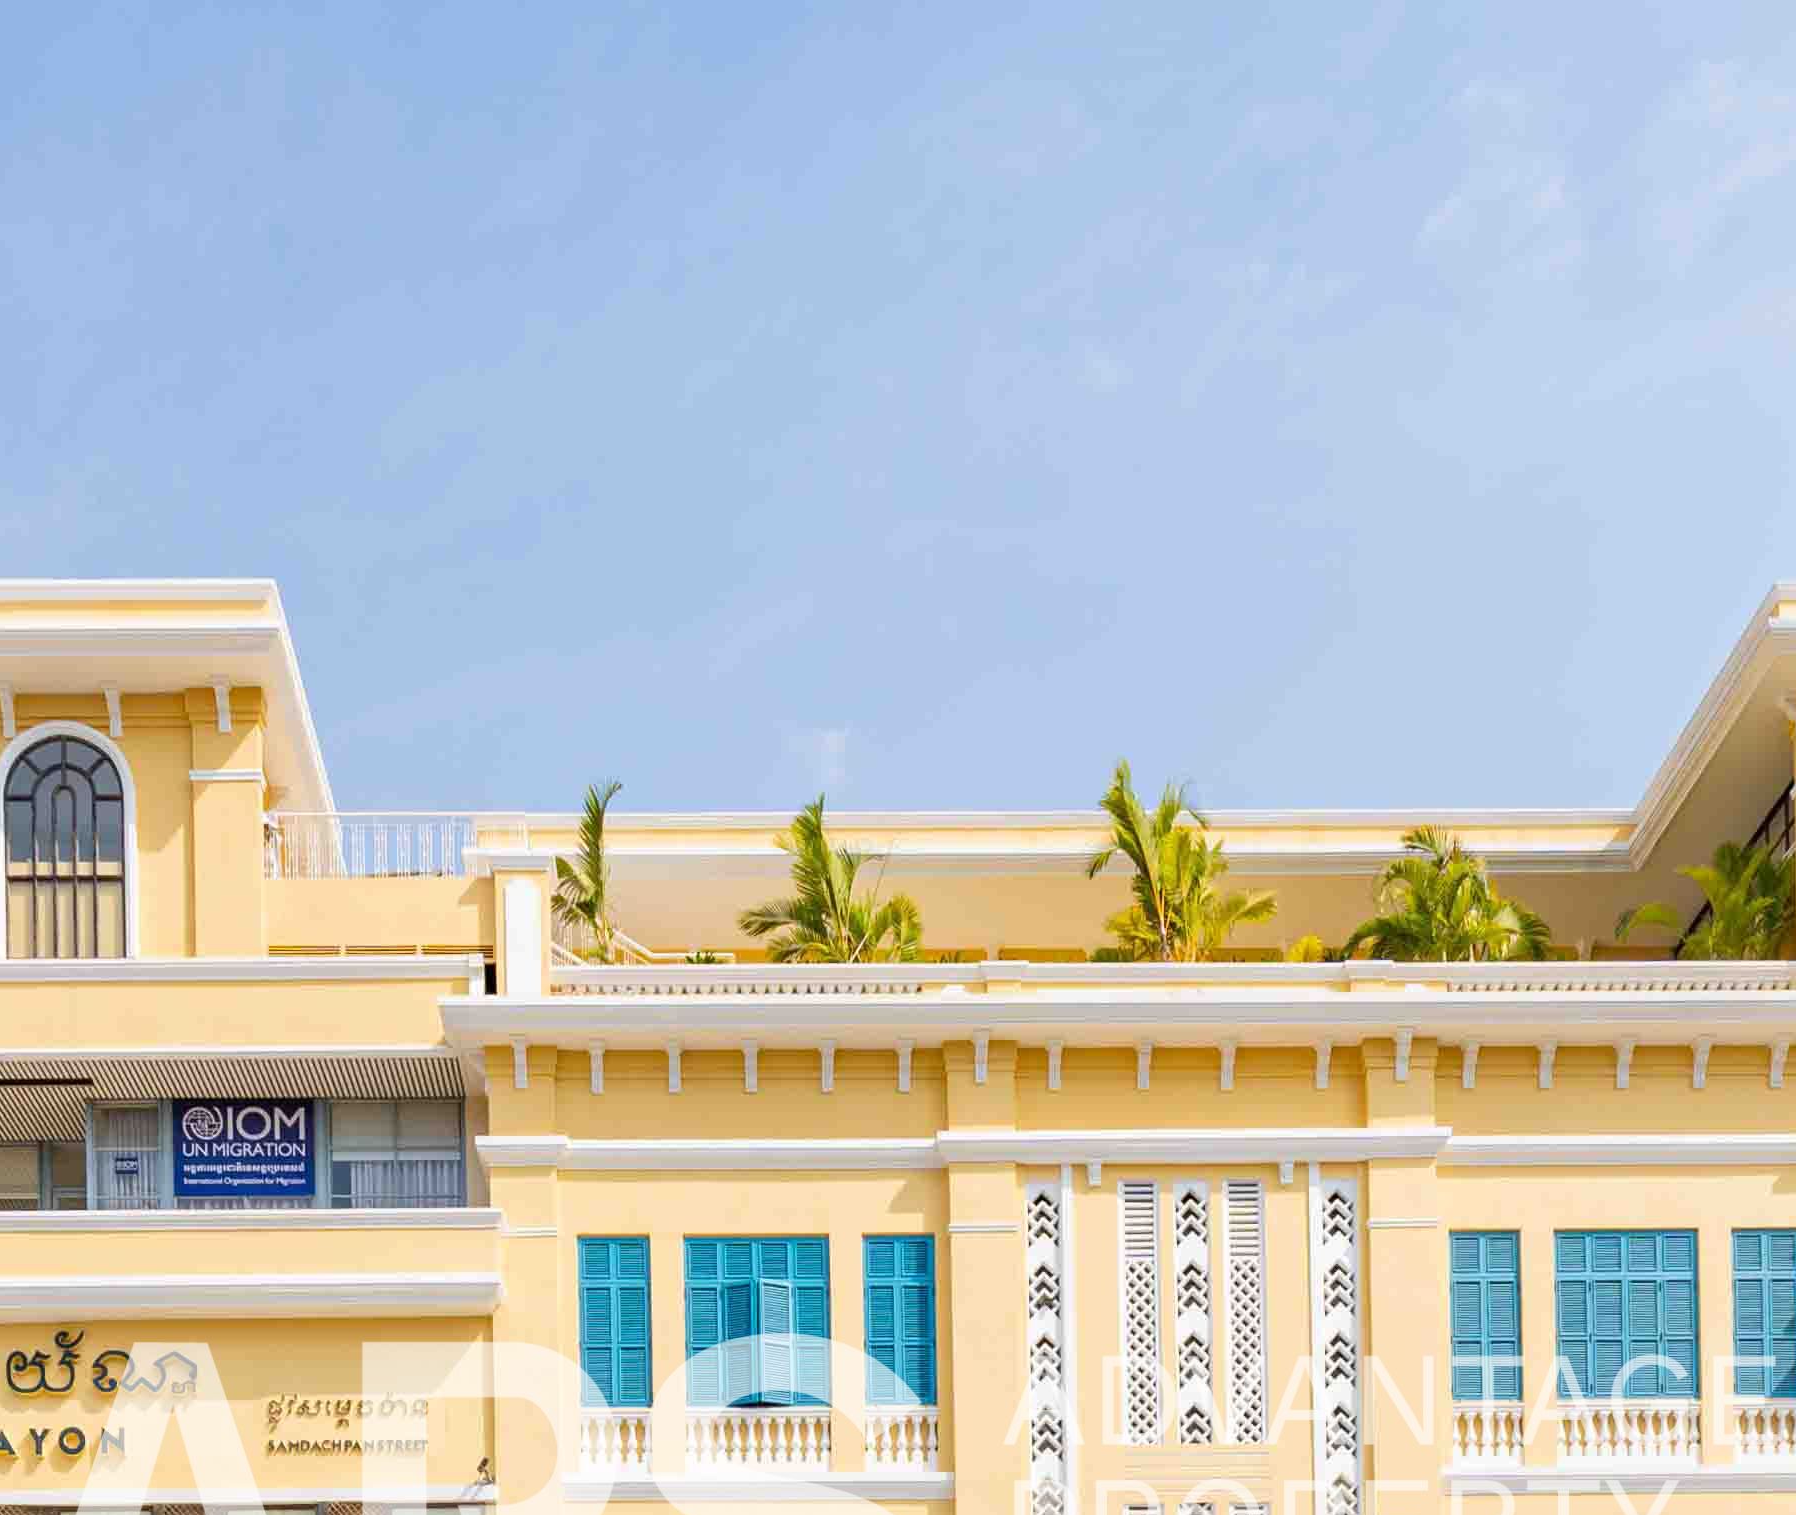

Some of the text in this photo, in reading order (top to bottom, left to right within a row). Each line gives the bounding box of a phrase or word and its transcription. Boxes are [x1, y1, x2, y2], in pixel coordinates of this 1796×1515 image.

[227, 1106, 305, 1141] IOM
[183, 1143, 305, 1157] UN MIGRATION
